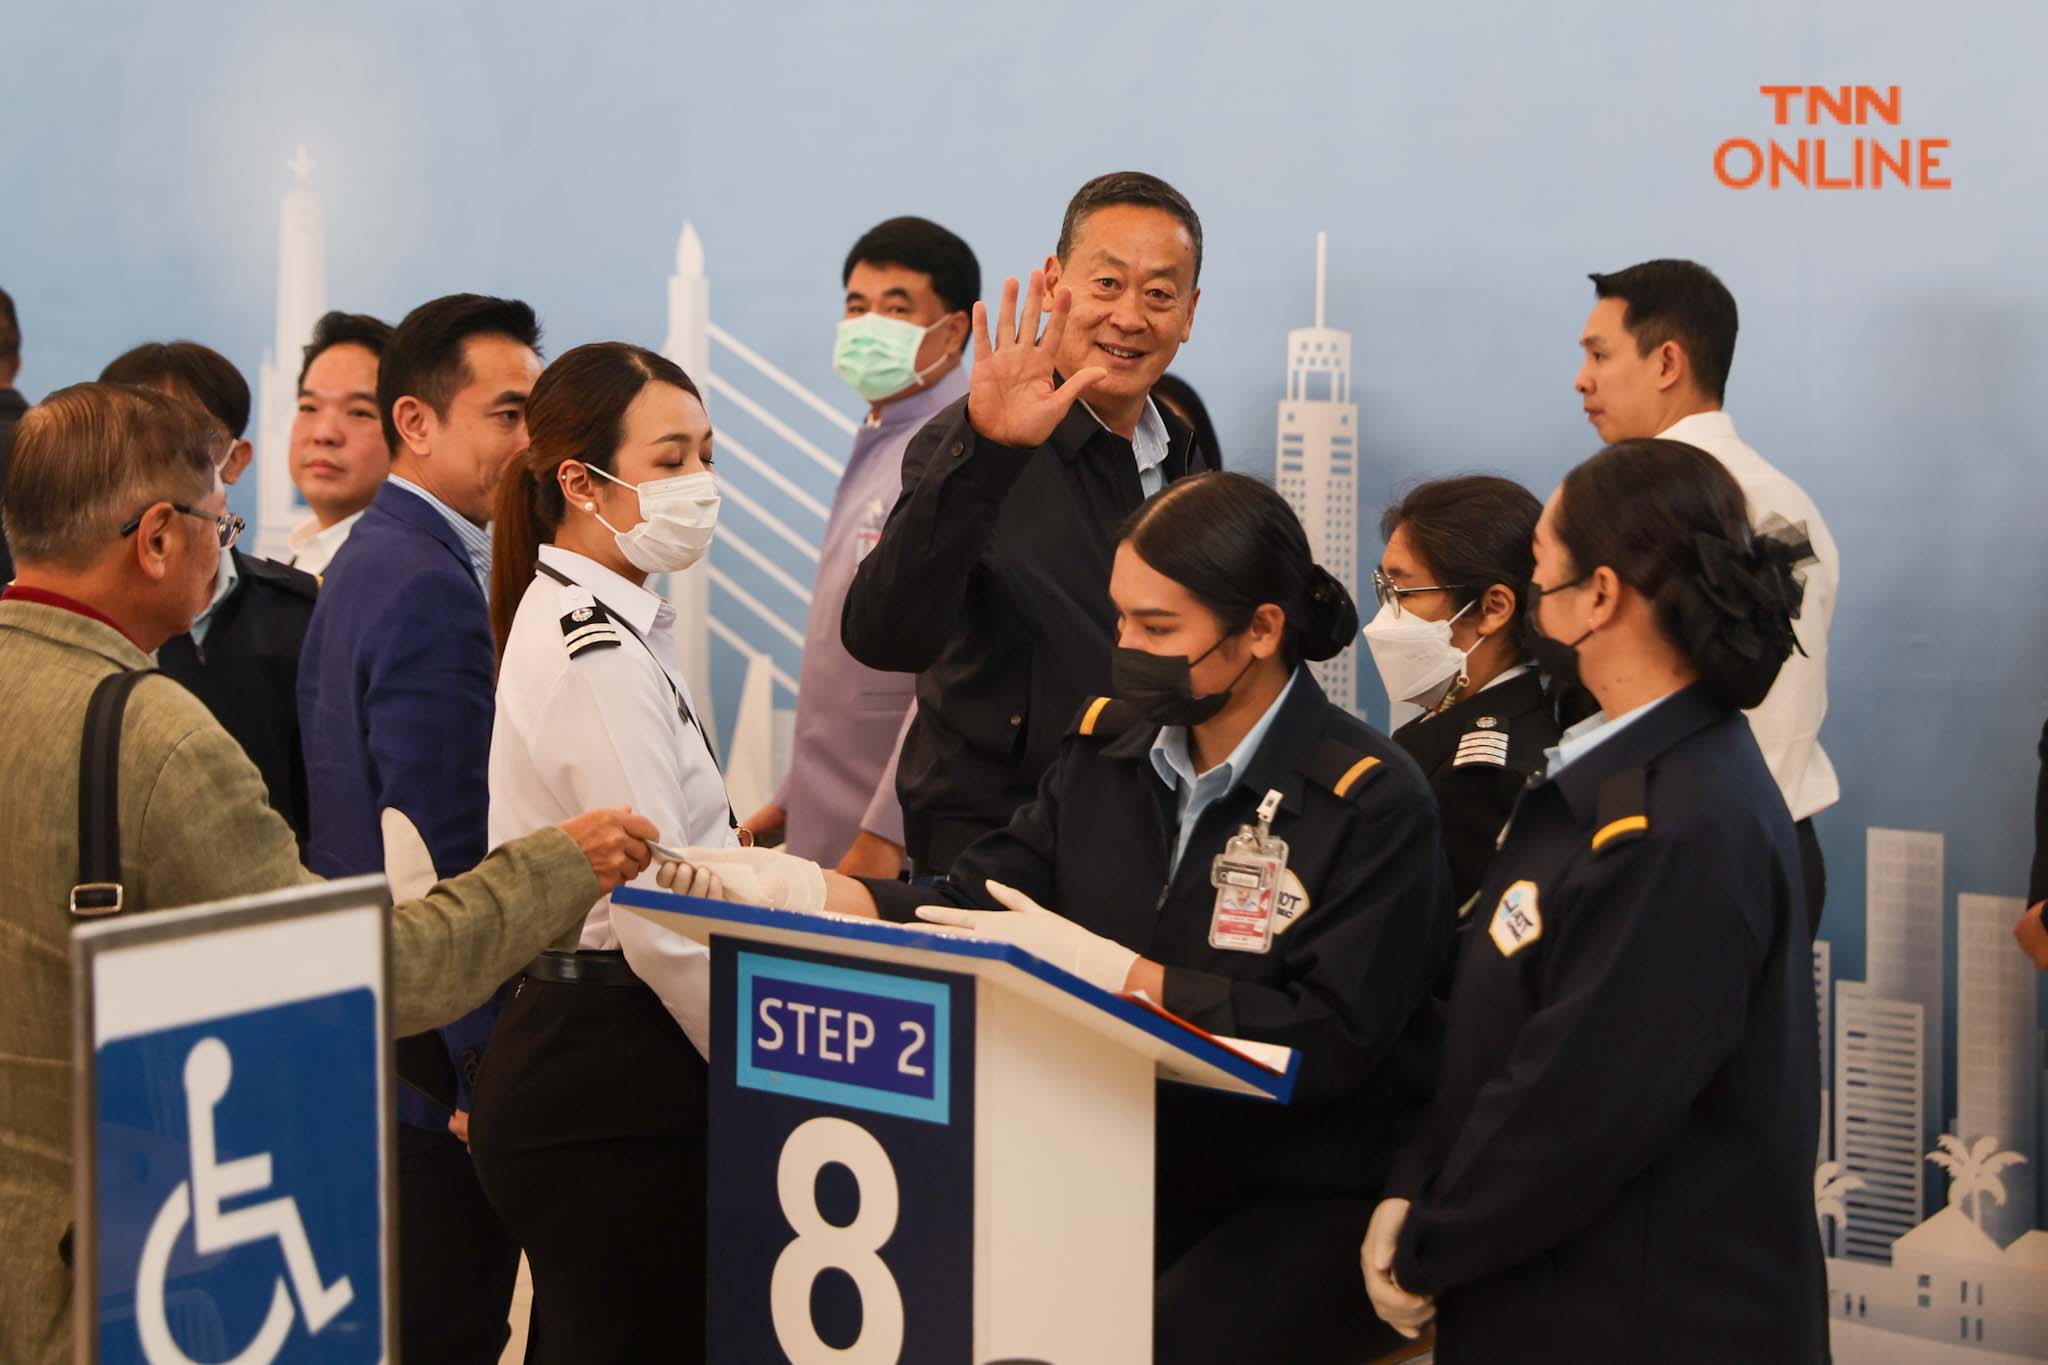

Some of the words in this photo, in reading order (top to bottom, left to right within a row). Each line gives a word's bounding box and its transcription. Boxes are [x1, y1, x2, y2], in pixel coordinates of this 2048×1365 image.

[757, 998, 875, 1064] STEP
[898, 1021, 926, 1077] 2
[770, 1116, 905, 1365] 8
